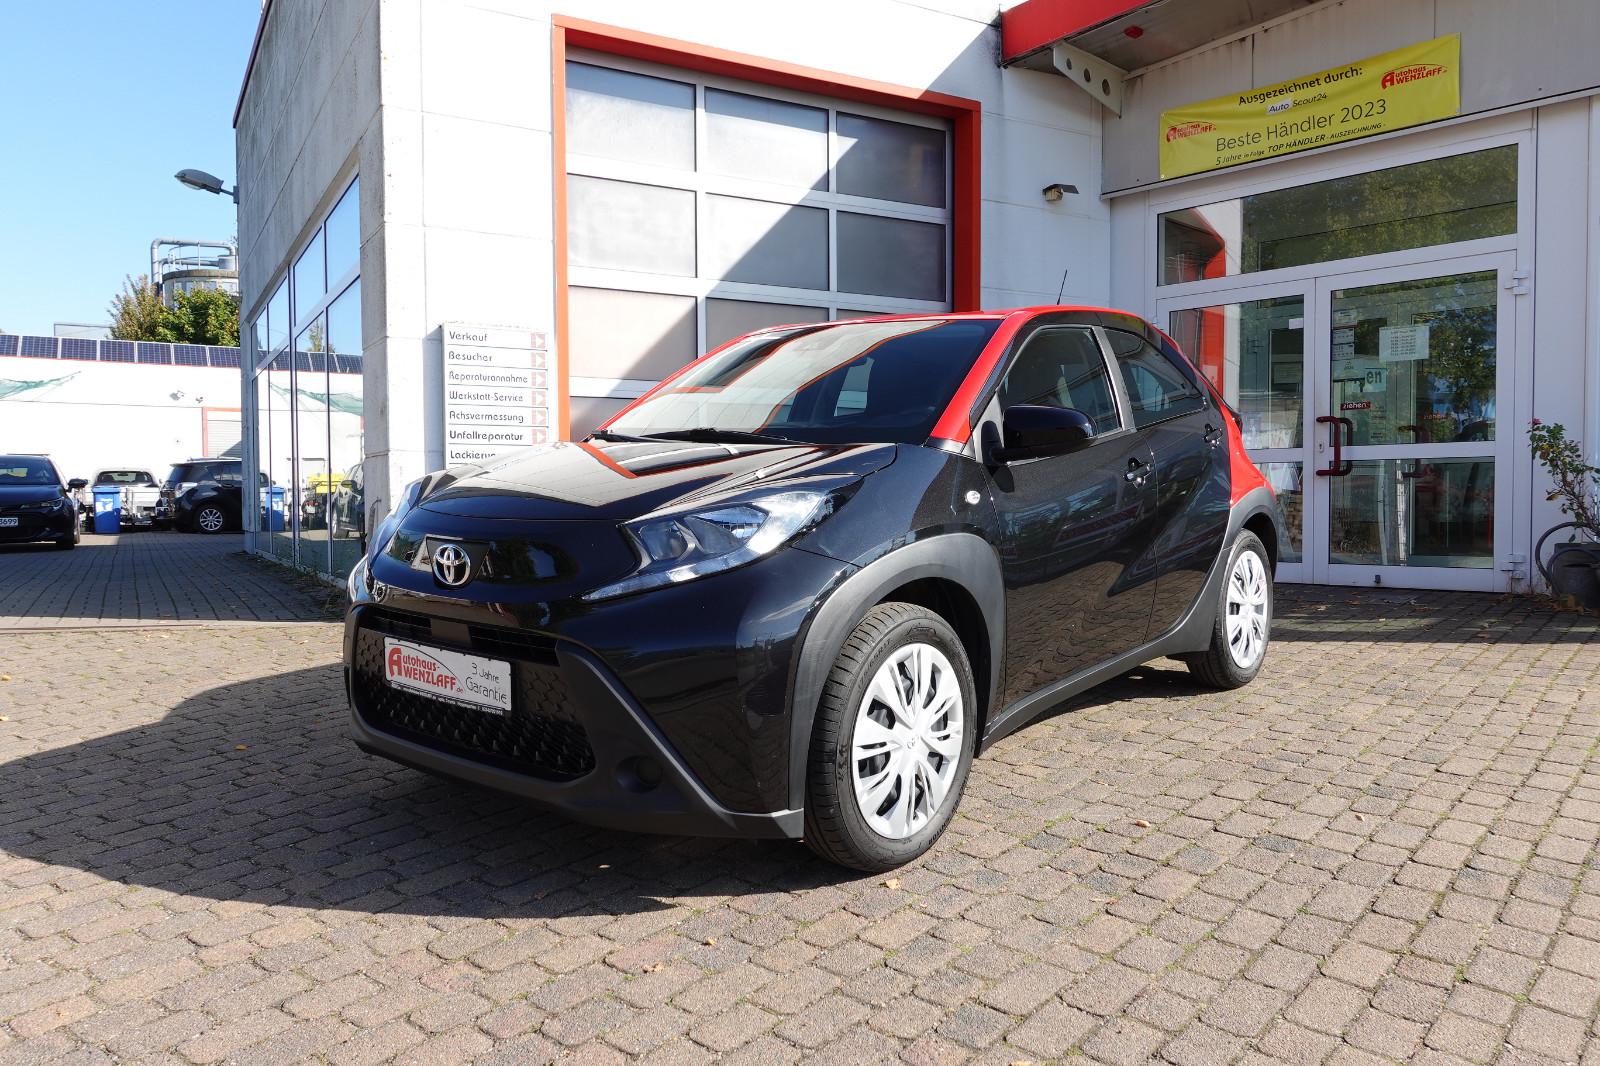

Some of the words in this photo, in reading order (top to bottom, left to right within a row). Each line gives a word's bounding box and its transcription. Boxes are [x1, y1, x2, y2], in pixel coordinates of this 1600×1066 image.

[1396, 67, 1442, 84] WENZLAFF
[1239, 78, 1321, 105] Ausgezeichnet
[1324, 67, 1363, 84] durch:
[1216, 131, 1261, 152] Beste
[1266, 113, 1335, 141] Händler
[1340, 99, 1387, 124] 2023
[1215, 156, 1222, 166] 5
[1268, 144, 1284, 152] TOP
[449, 331, 488, 342] Verkauf
[448, 350, 492, 362] Besucher
[449, 371, 528, 383] Reparaturannahme
[449, 391, 523, 402] Werkstatt-Service
[1343, 401, 1367, 409] ziehen
[449, 410, 524, 423] Achsvermessung
[449, 430, 524, 442] Unfallreparatur
[403, 664, 456, 691] WENZLAFF
[471, 662, 478, 675] 3
[479, 669, 500, 684] Jahre
[465, 676, 508, 704] Garantie
